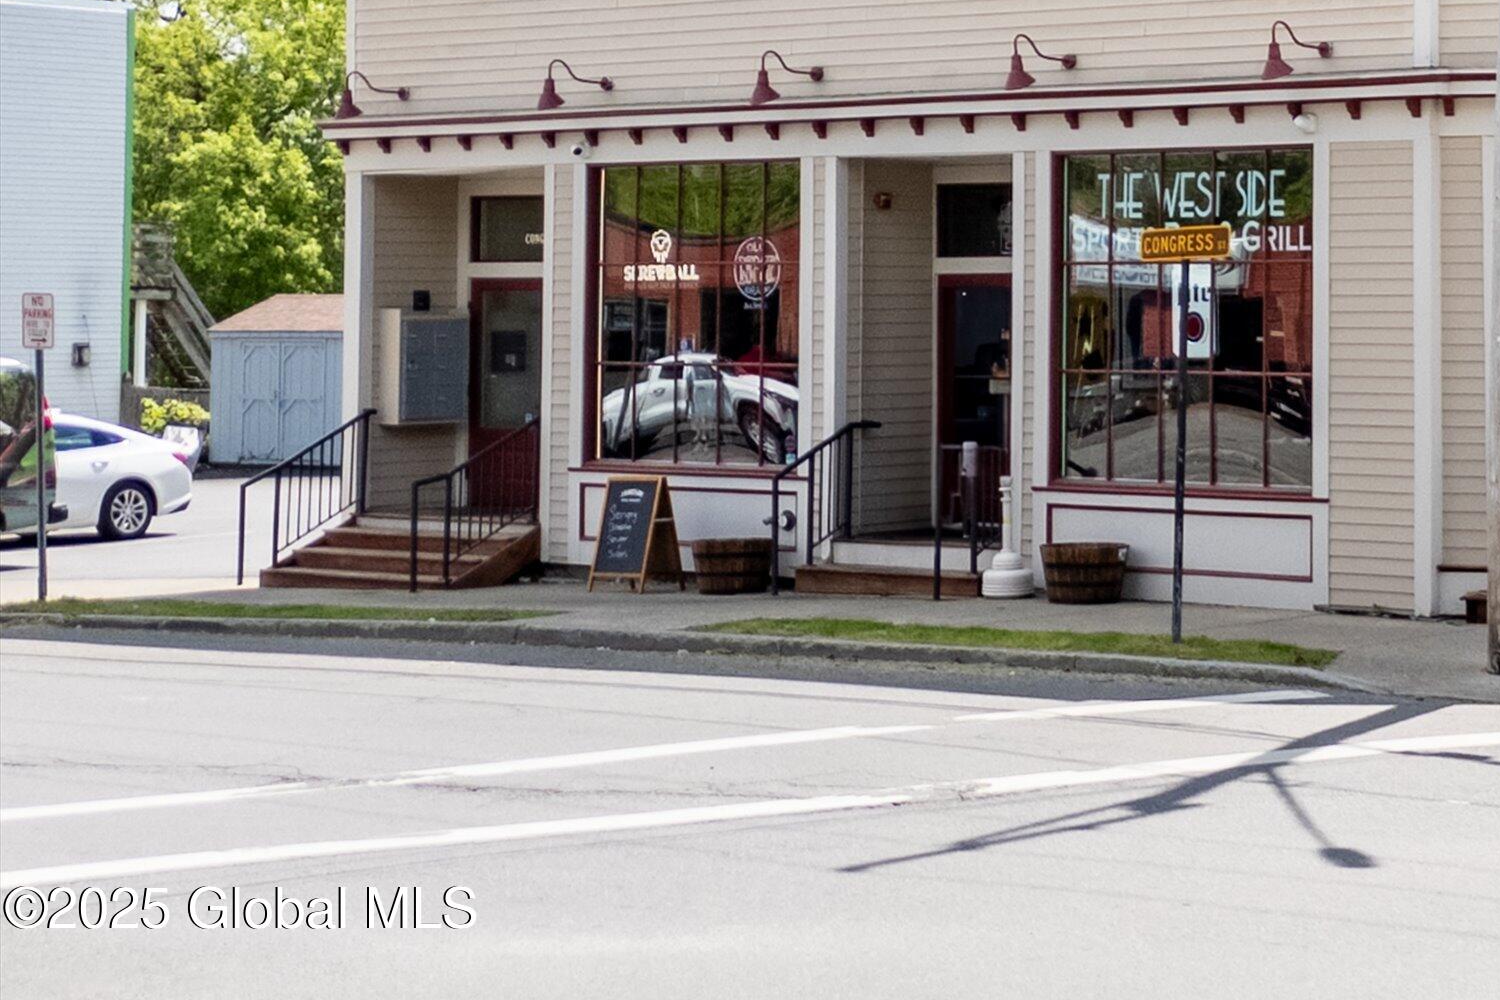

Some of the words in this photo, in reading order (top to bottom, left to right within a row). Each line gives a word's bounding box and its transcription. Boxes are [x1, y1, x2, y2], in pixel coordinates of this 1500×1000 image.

[1098, 171, 1143, 219] THE
[1153, 171, 1226, 219] WEST
[1236, 169, 1287, 218] SIDE
[1072, 224, 1143, 252] SPORT
[1242, 220, 1312, 252] GRILL
[1143, 232, 1215, 255] CONGRESS
[31, 296, 44, 306] NO
[23, 308, 52, 319] PARKING
